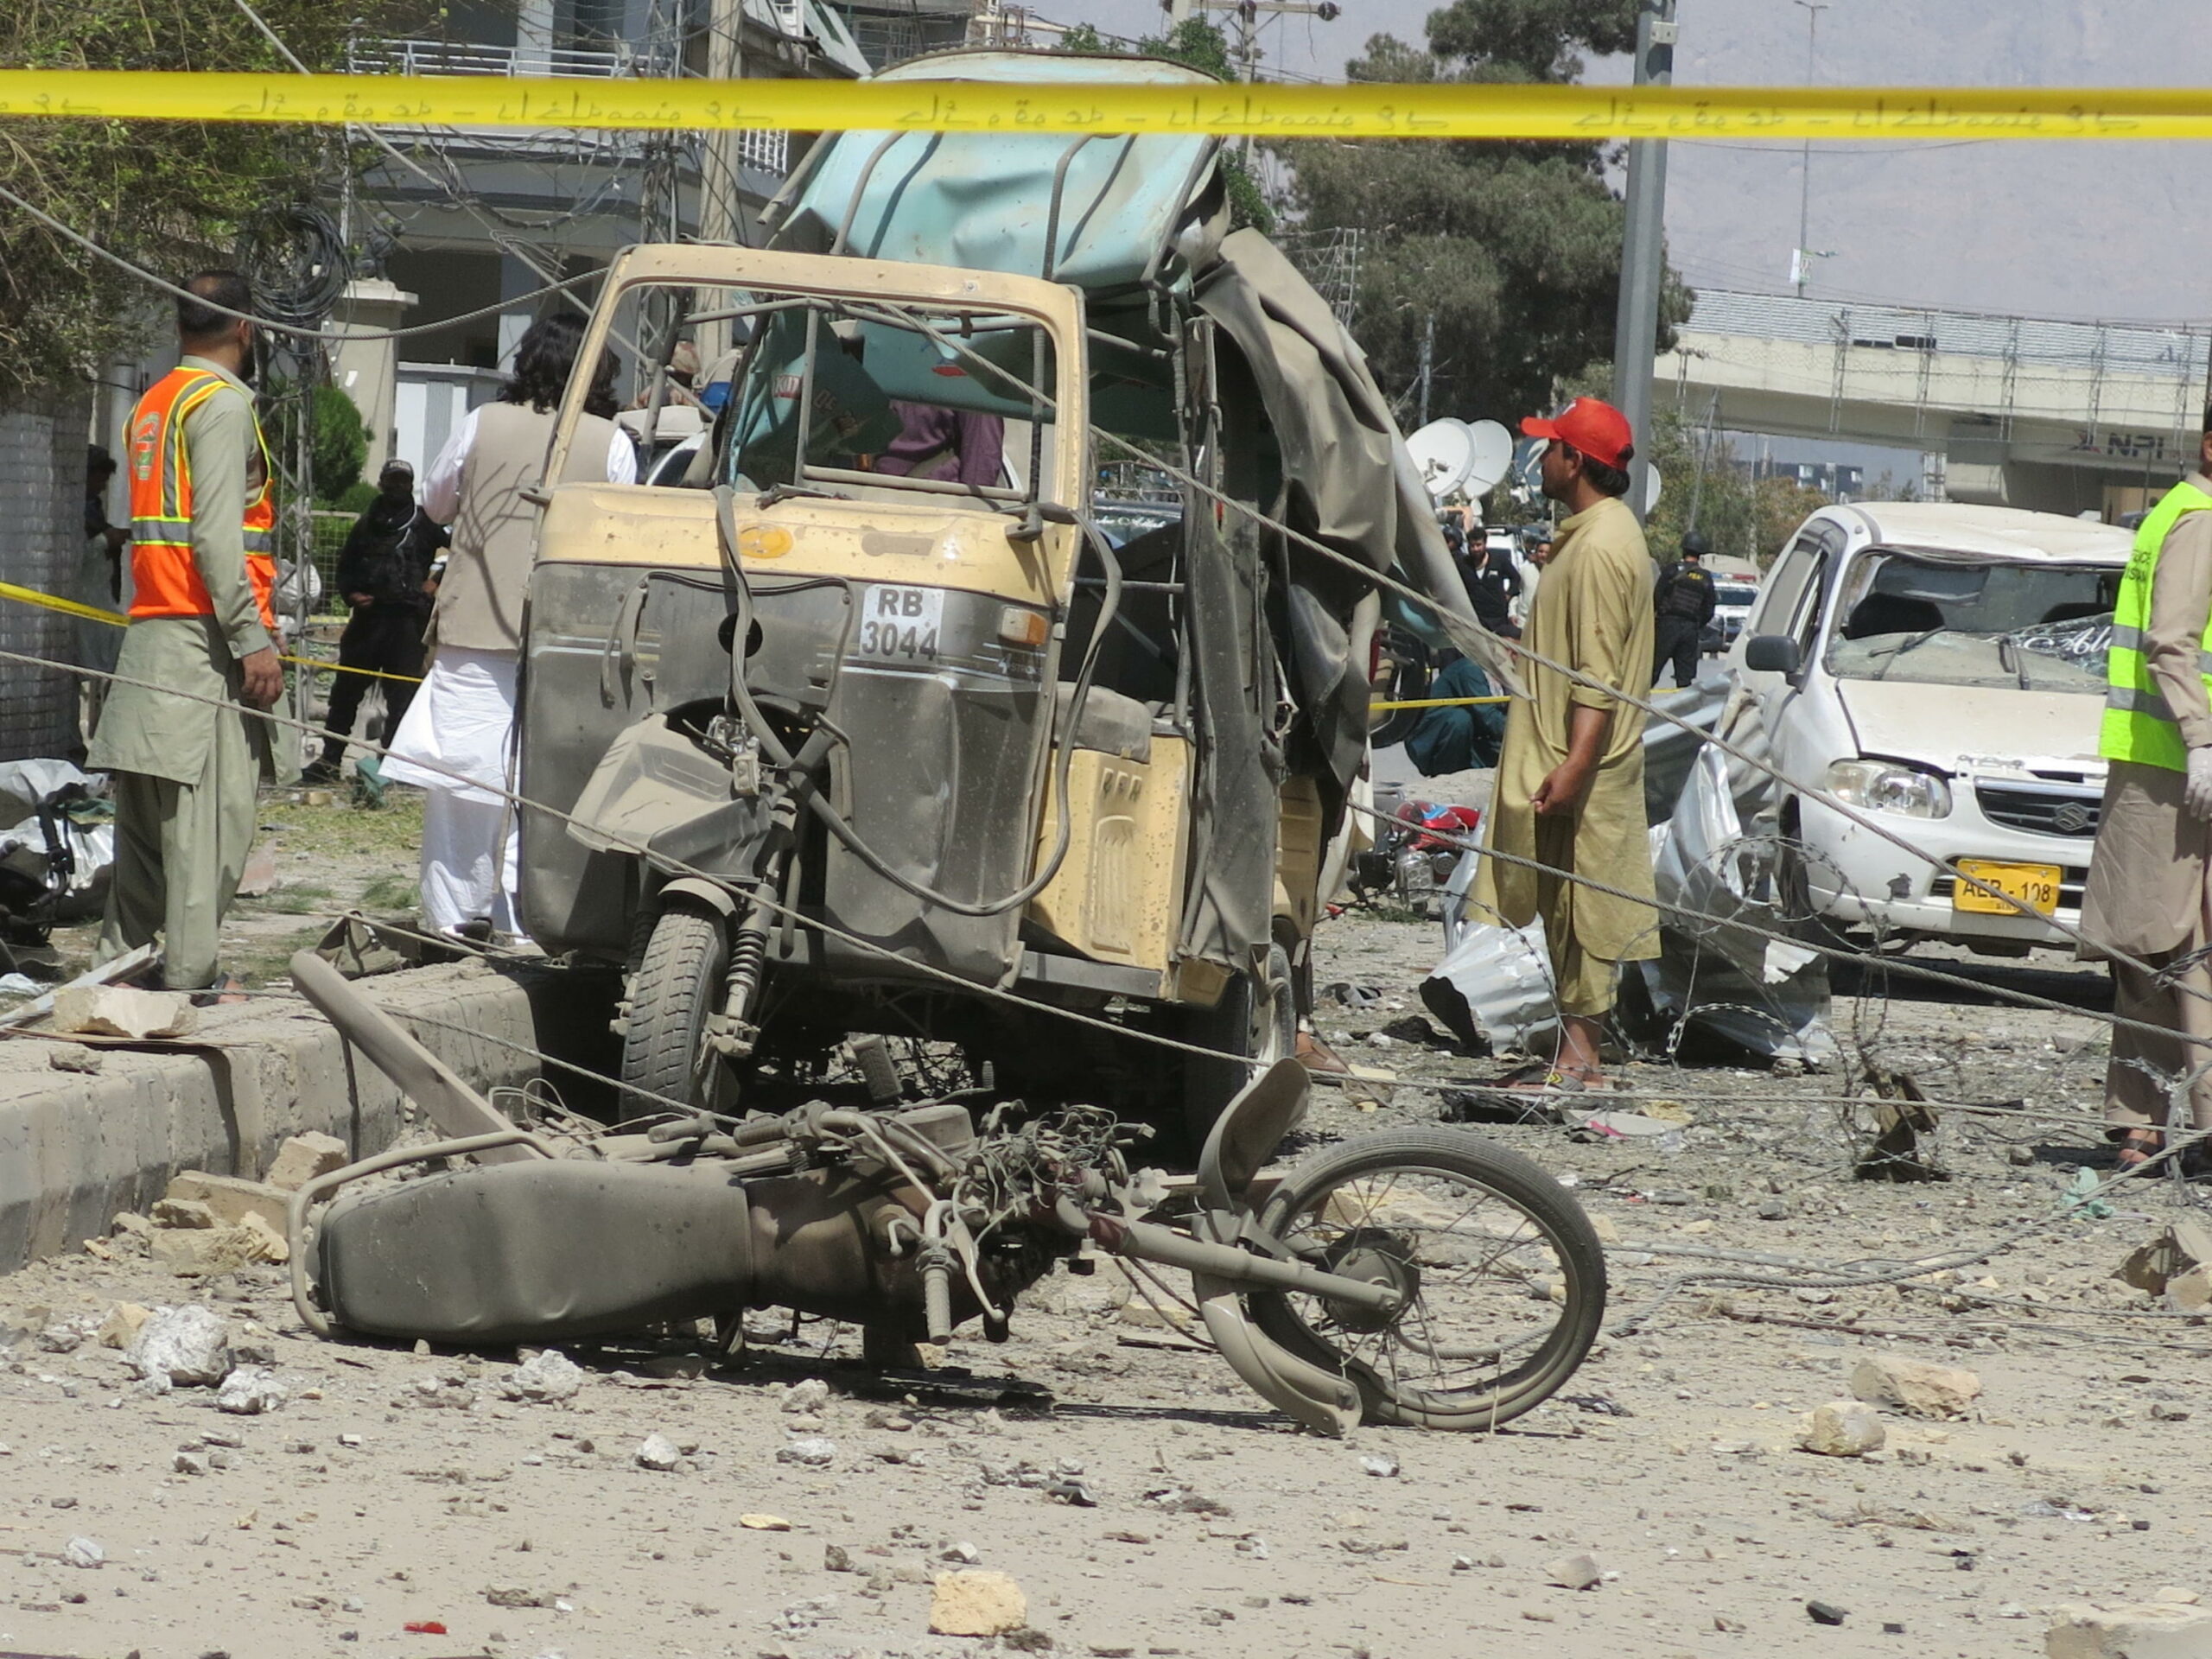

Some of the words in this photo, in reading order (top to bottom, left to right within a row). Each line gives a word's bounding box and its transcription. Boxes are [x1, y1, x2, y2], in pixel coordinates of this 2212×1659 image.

[877, 588, 924, 618] RB
[861, 620, 938, 661] 3044
[2021, 882, 2051, 903] 108
